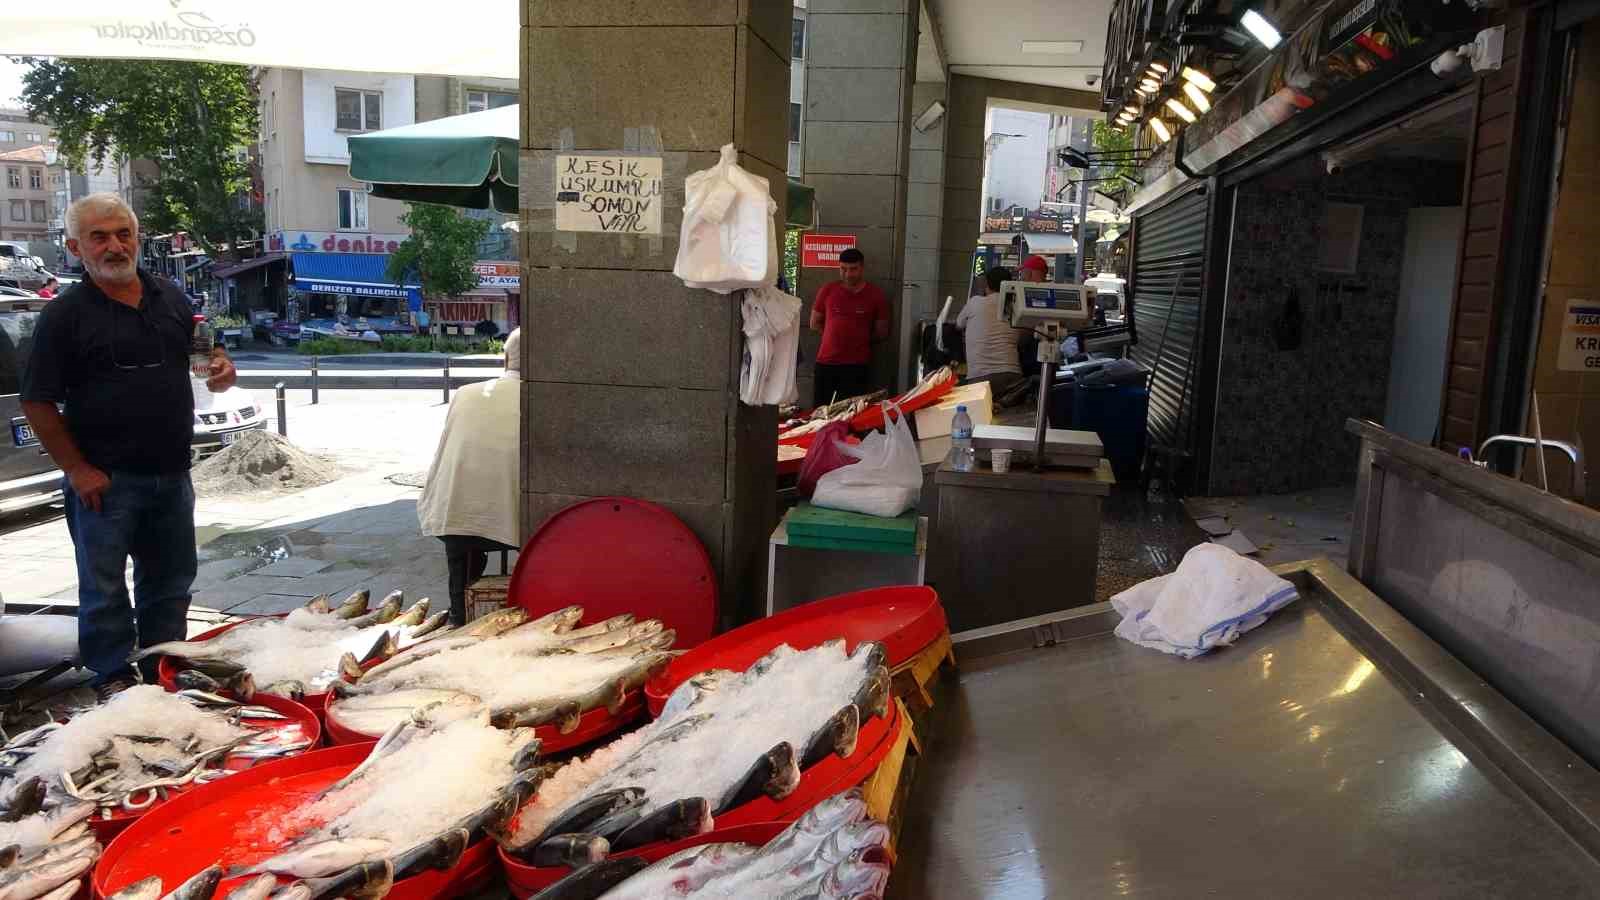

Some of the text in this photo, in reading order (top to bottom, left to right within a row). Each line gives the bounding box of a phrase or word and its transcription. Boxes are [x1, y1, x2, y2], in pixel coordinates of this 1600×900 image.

[581, 194, 651, 214] SOMON
[322, 234, 400, 253] denize
[1576, 336, 1600, 351] KR
